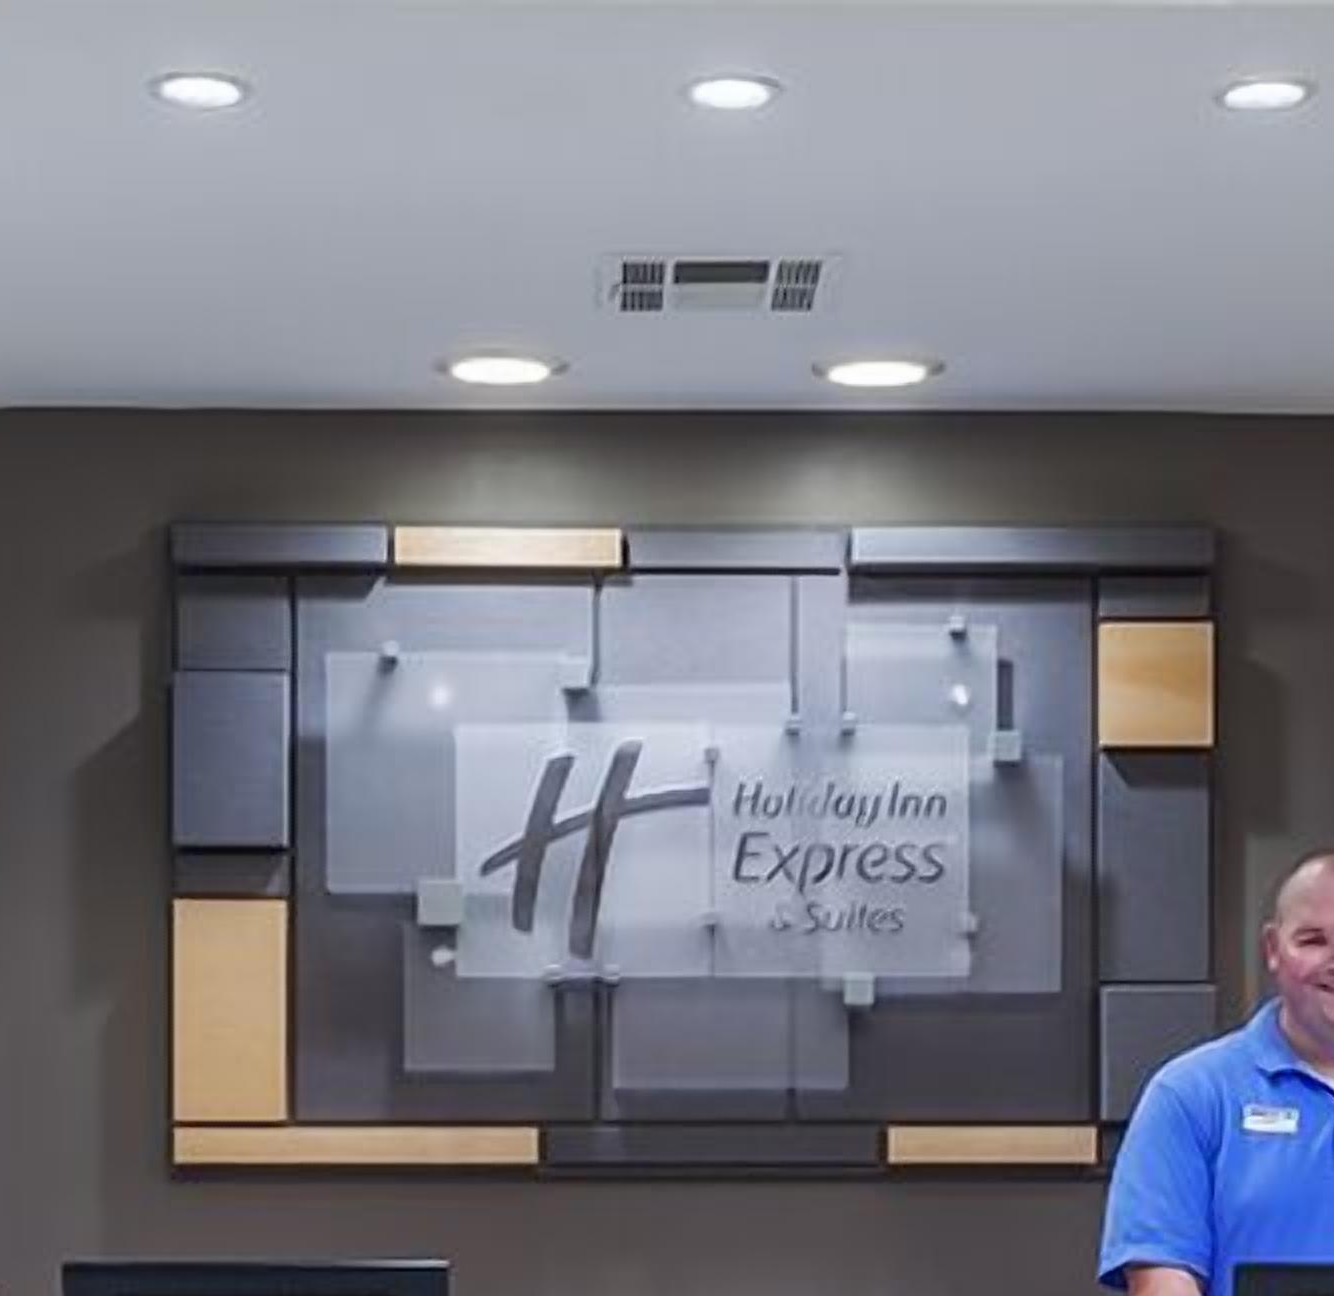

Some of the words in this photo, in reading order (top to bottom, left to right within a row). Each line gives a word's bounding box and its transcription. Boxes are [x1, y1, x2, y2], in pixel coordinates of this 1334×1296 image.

[887, 781, 947, 818] Inn
[732, 831, 947, 896] Express
[803, 901, 905, 936] Suites
